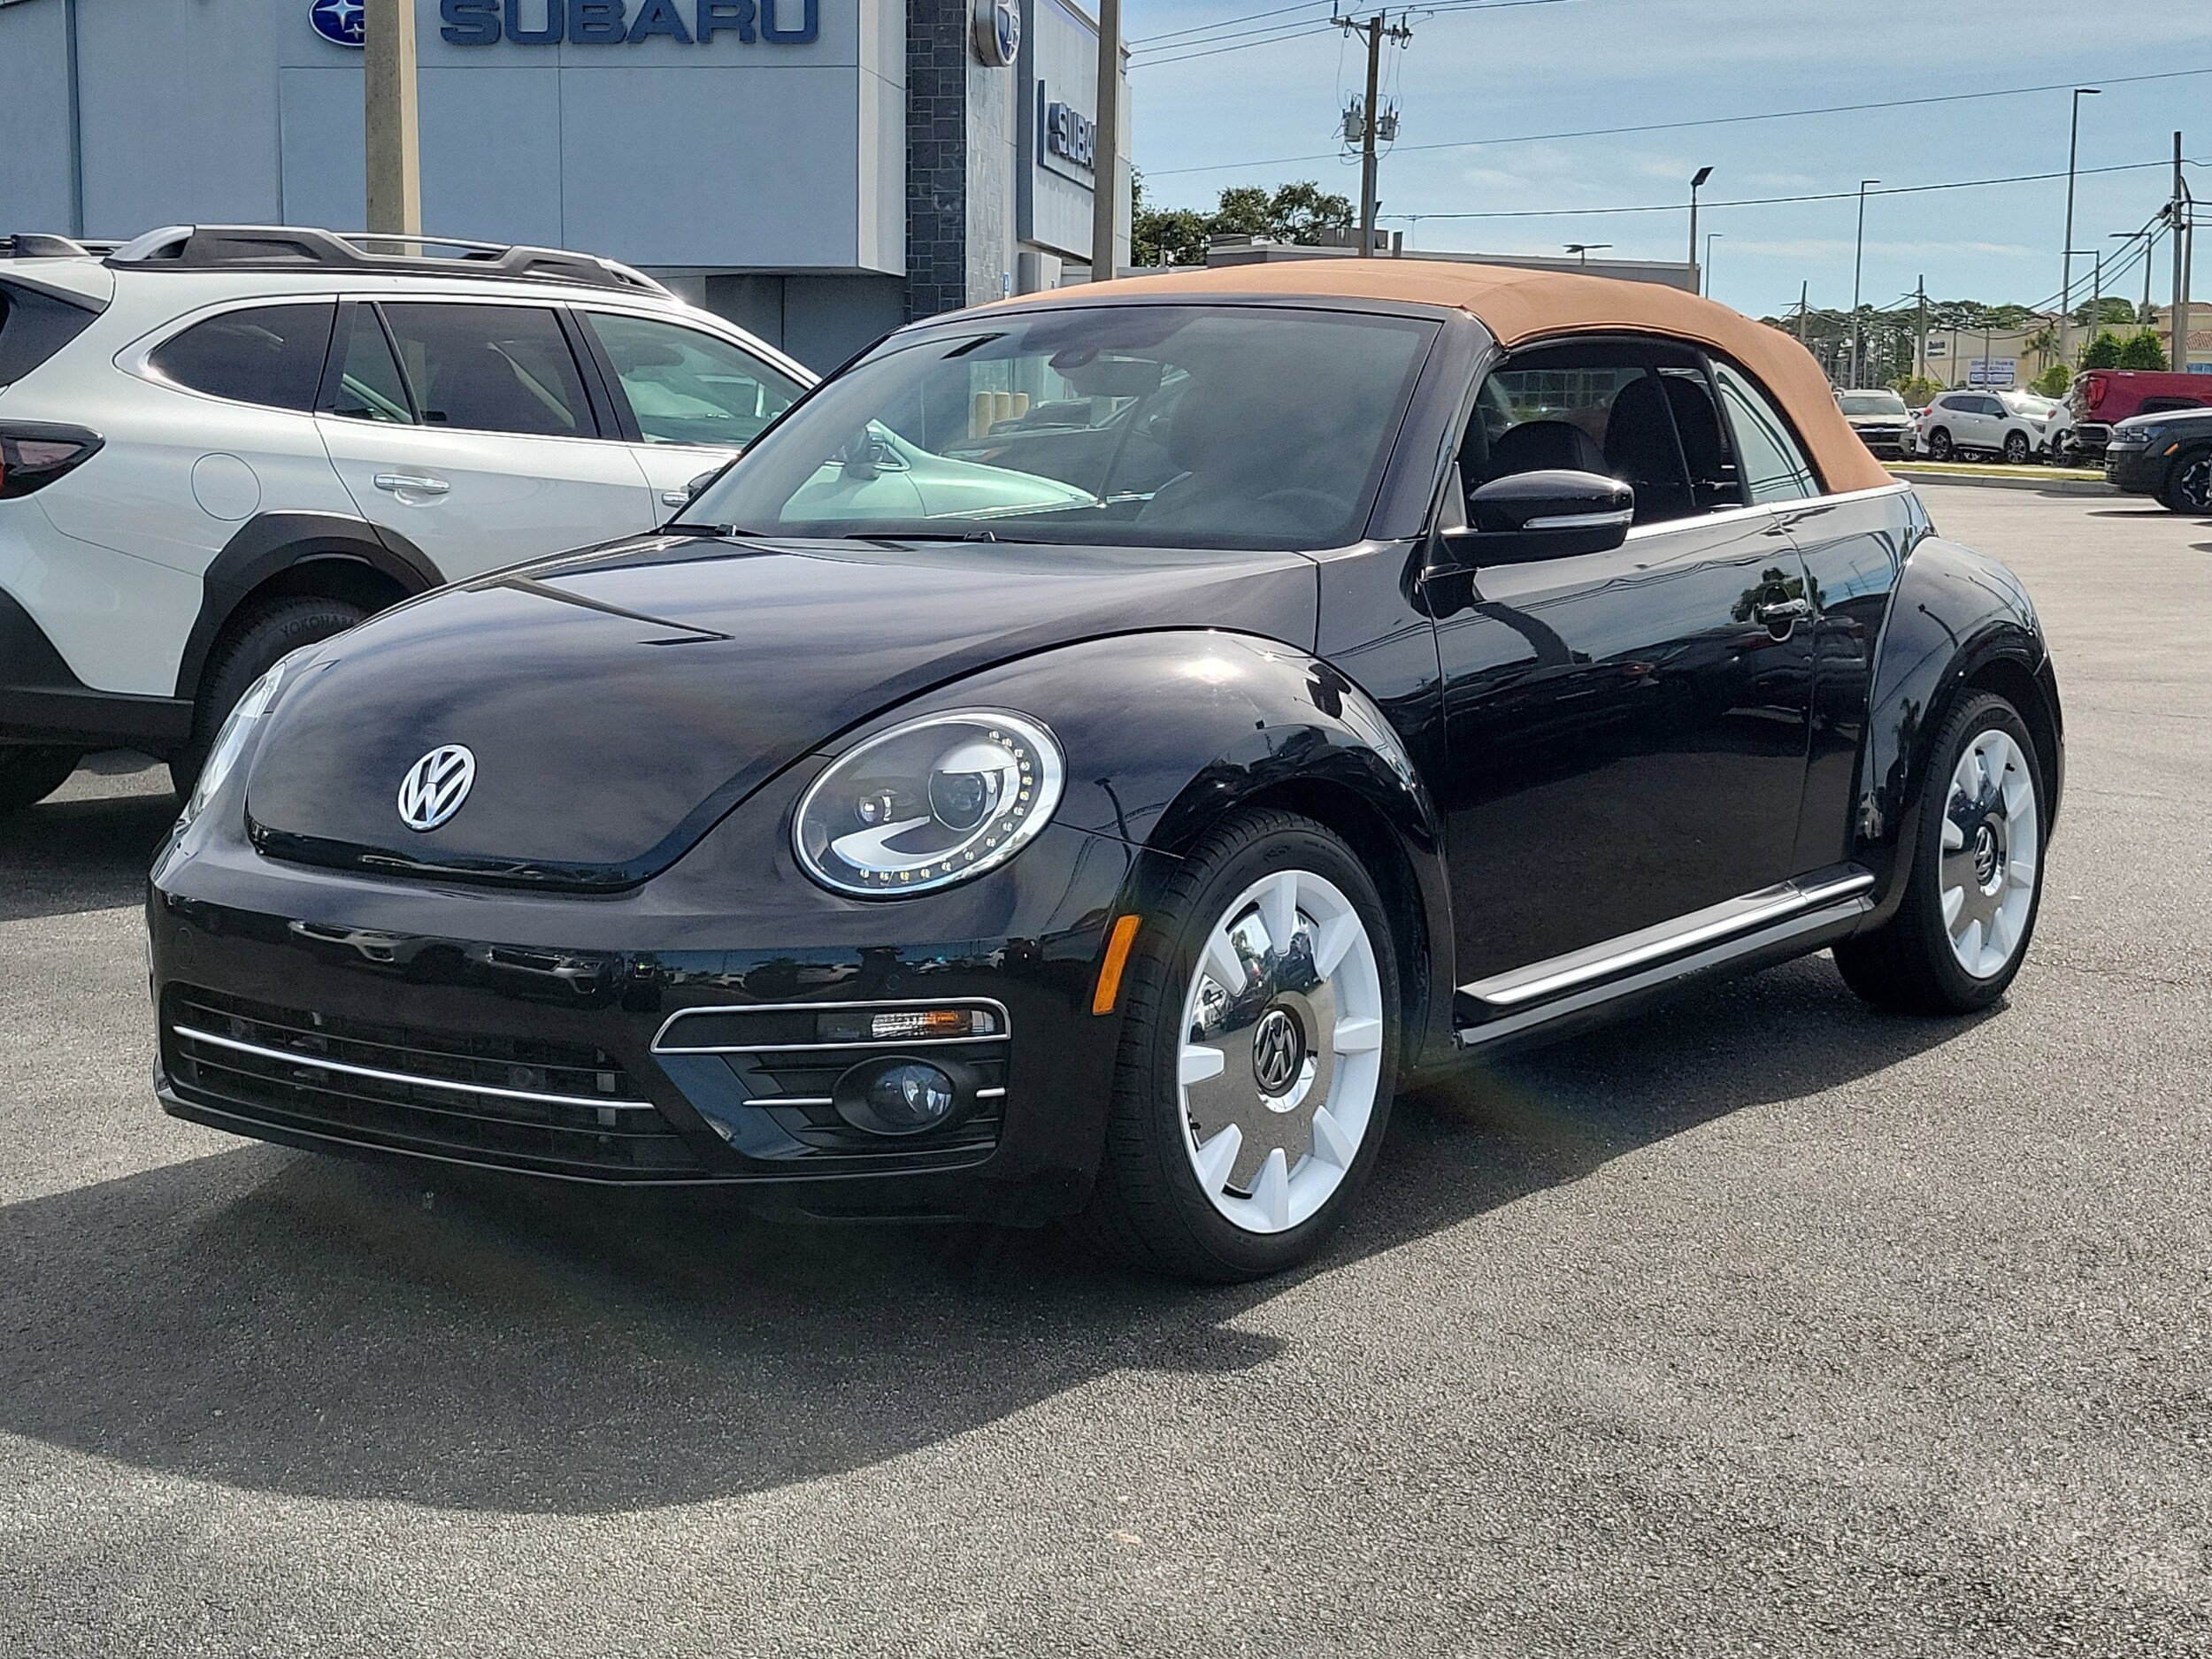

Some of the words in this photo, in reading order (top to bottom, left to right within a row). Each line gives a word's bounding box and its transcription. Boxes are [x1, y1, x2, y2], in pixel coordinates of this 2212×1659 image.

[440, 0, 819, 44] SUBARU
[1048, 102, 1095, 169] SUBA
[279, 612, 354, 635] YOKOHAM
[399, 745, 474, 829] VW
[1254, 1010, 1296, 1088] VW
